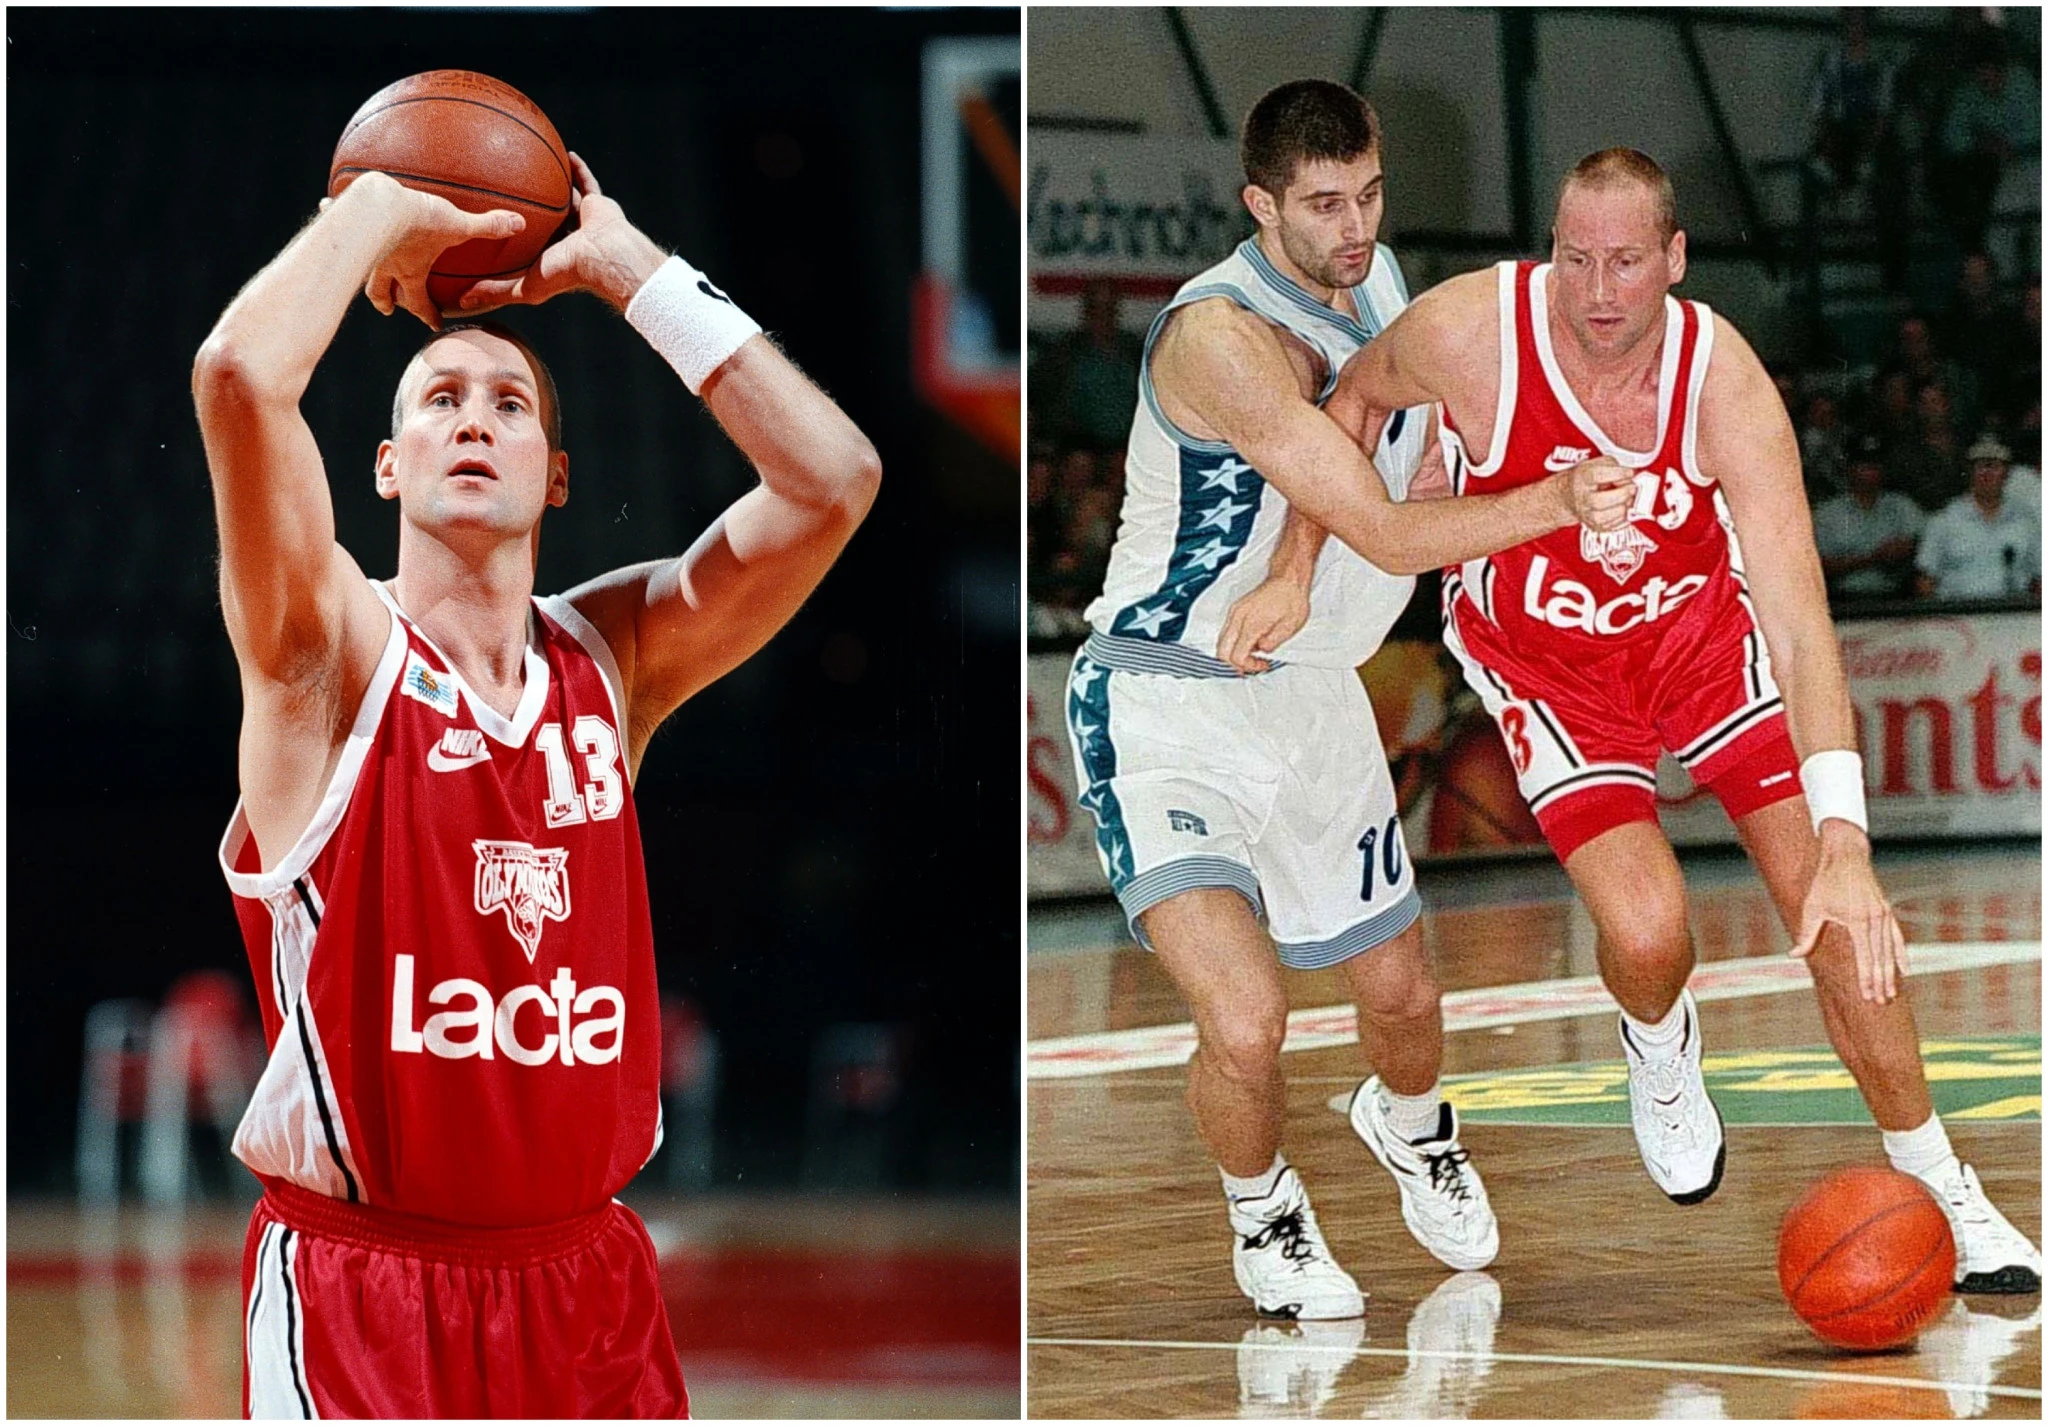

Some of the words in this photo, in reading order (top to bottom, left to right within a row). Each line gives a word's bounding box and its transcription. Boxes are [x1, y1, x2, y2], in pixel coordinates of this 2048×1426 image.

[1552, 446, 1591, 462] NIKE
[1627, 466, 1694, 531] 13
[1524, 554, 1709, 635] Lacta
[535, 714, 625, 829] 13
[1357, 815, 1402, 902] 10
[390, 952, 626, 1067] Lacta
